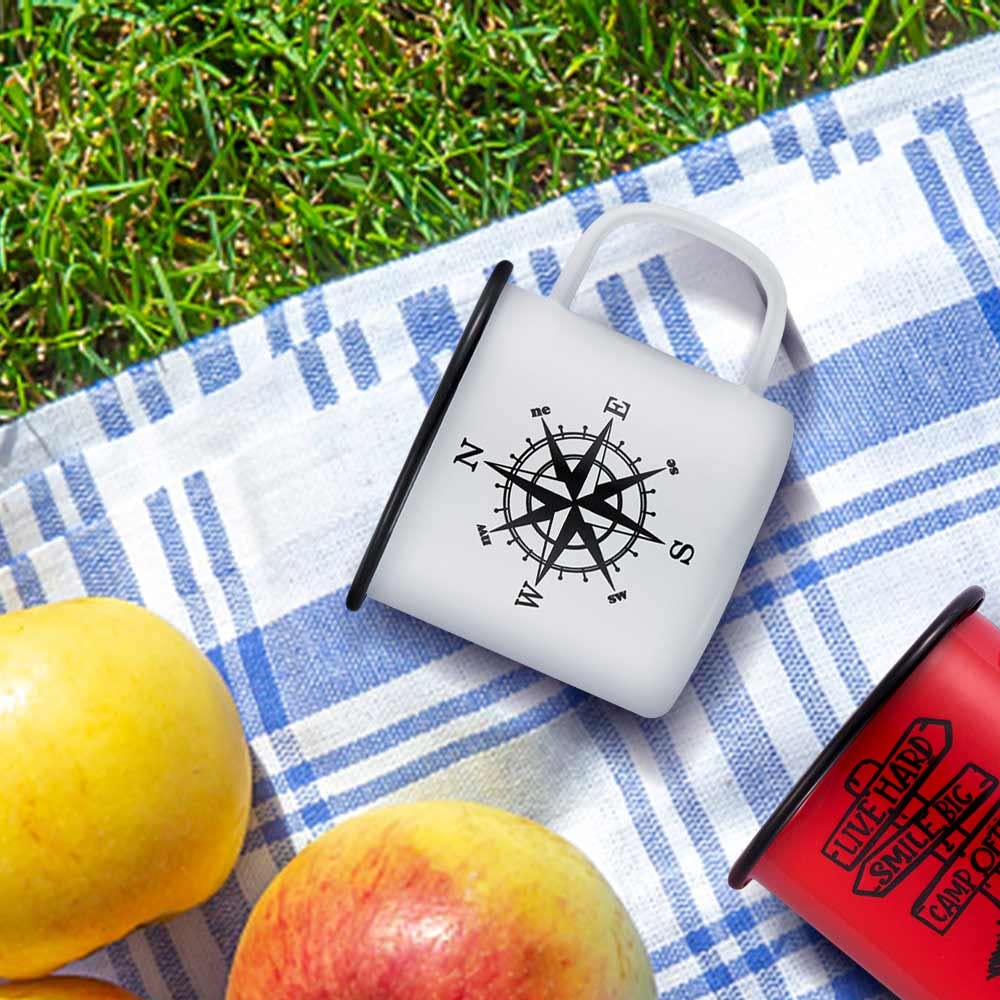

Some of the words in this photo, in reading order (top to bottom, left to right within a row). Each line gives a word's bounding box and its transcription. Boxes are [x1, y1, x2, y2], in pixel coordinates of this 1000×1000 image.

[603, 396, 631, 421] E
[453, 437, 485, 472] N
[668, 539, 695, 566] S
[514, 580, 544, 609] W
[837, 798, 889, 856] LIVE
[871, 735, 934, 806] HARD
[869, 805, 940, 886] SMILE
[932, 784, 973, 825] BIG
[928, 868, 976, 923] CAMP
